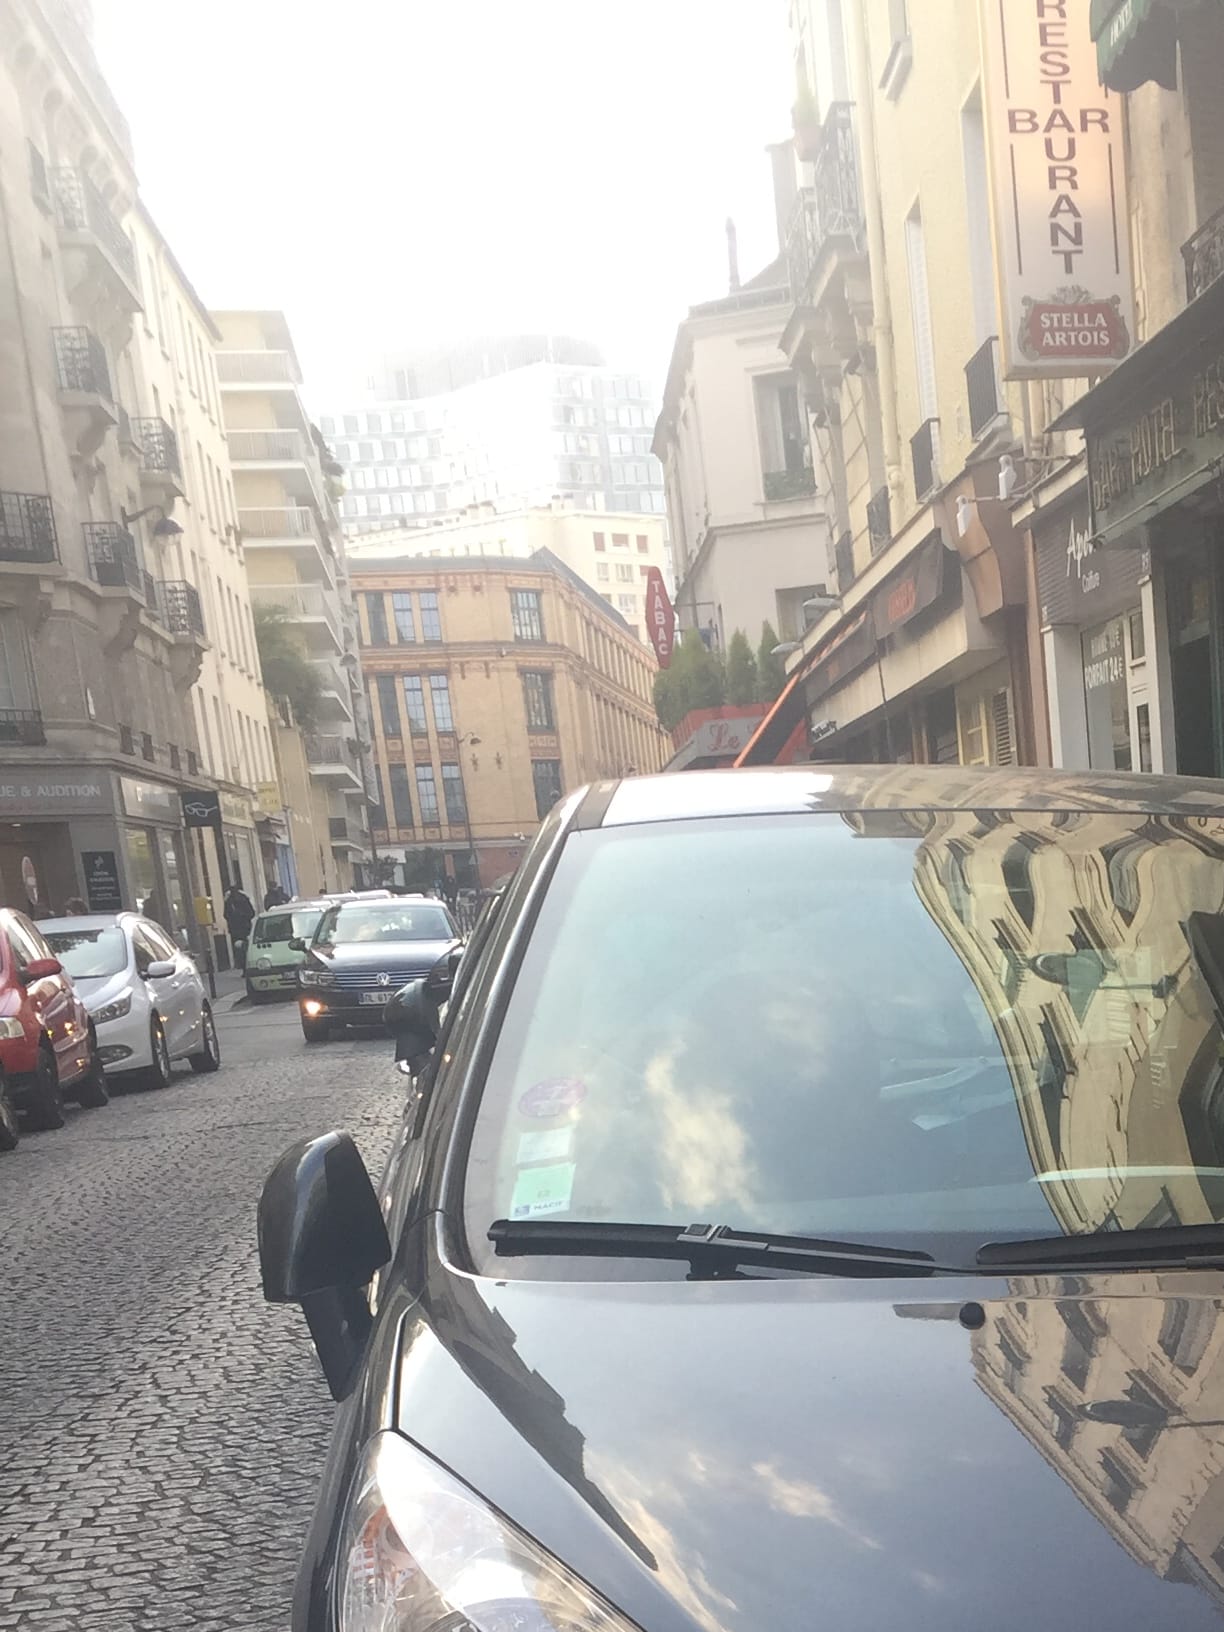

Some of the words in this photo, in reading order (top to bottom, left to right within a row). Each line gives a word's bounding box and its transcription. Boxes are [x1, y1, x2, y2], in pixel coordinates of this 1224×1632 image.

[1007, 108, 1110, 133] BAR
[1037, 0, 1083, 274] RESTAURANT
[1040, 312, 1108, 328] STELLA
[1042, 330, 1110, 346] ARTOIS
[1130, 398, 1183, 485] HOTEL
[651, 580, 669, 655] TABAC
[709, 721, 740, 751] Le
[37, 784, 102, 798] AUDITION
